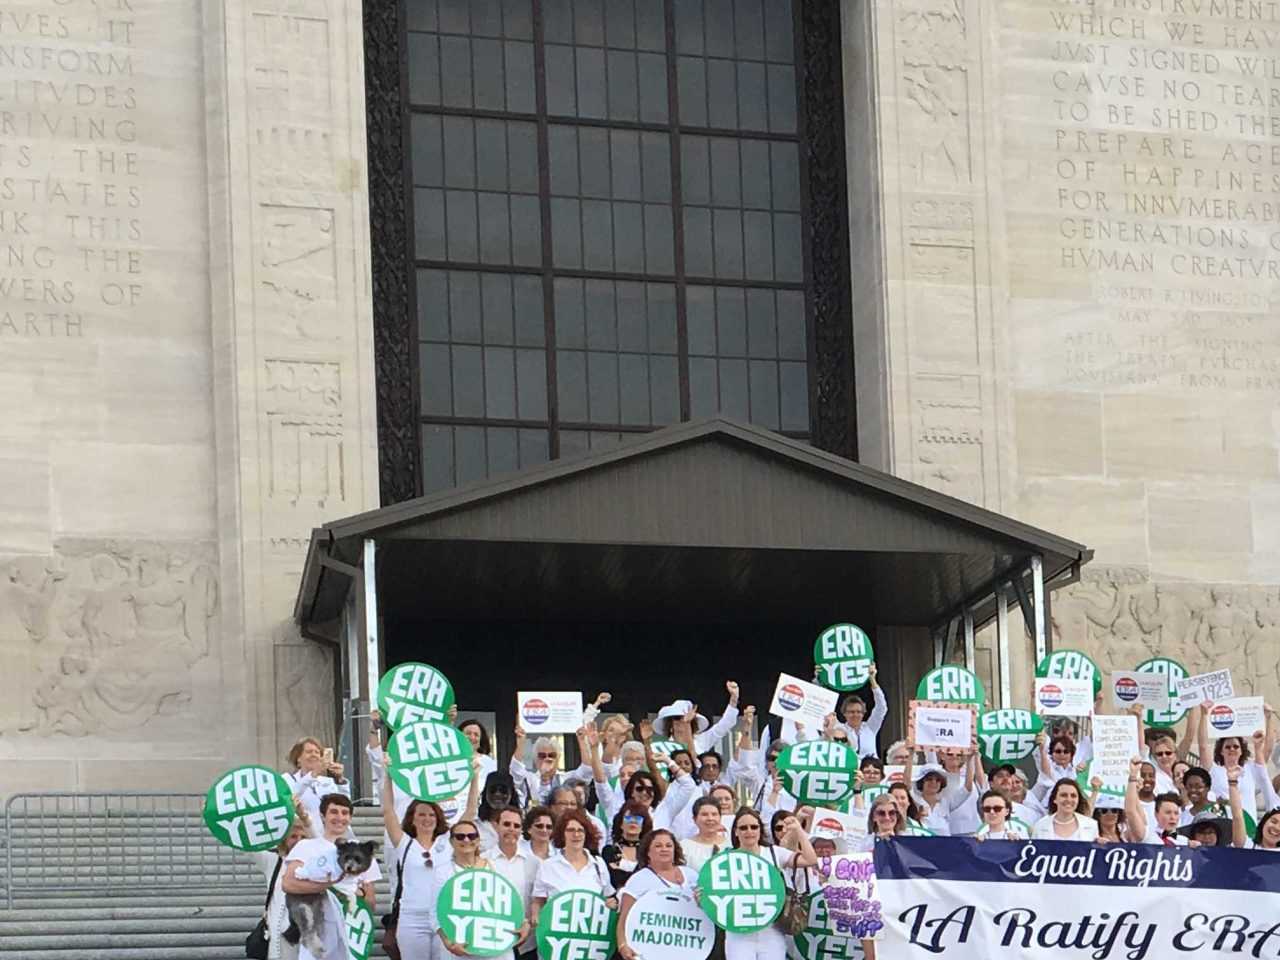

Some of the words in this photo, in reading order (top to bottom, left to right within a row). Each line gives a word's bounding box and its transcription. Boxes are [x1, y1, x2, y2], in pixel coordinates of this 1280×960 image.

[107, 20, 135, 43] IT
[1049, 11, 1146, 39] WHICH
[1164, 21, 1205, 45] WE
[1128, 47, 1220, 74] SIGNED
[1052, 71, 1145, 97] CAVSE
[1163, 79, 1200, 102] NO
[1053, 99, 1089, 122] TO
[1107, 104, 1135, 125] BE
[1151, 108, 1218, 132] SHED
[1055, 129, 1194, 159] PREPARE
[73, 149, 138, 176] THE
[1056, 158, 1096, 181] OF
[1057, 188, 1109, 212] FOR
[65, 215, 141, 241] THIS
[1059, 217, 1249, 249] GENERATIONS
[80, 247, 141, 274] THE
[1060, 247, 1154, 273] HVMAN
[100, 281, 143, 306] OF
[822, 625, 866, 659] ERA
[821, 661, 872, 686] YES
[1047, 651, 1095, 680] ERA
[390, 665, 448, 708] ERA
[926, 667, 976, 700] ERA
[936, 727, 954, 737] RA
[982, 709, 1032, 730] ERA
[396, 721, 460, 763] ERA
[789, 741, 846, 767] ERA
[980, 733, 1037, 760] YES
[215, 768, 279, 815] ERA
[398, 759, 470, 797] YES
[784, 770, 850, 800] YES
[216, 806, 289, 847] YES
[710, 852, 771, 890] ERA
[1014, 846, 1094, 883] Equal
[1104, 847, 1193, 887] Rights
[452, 871, 512, 916] ERA
[551, 892, 610, 935] ERA
[639, 911, 702, 932] FEMINIST
[707, 894, 777, 927] YES
[447, 914, 515, 950] YES
[631, 928, 706, 950] MAJORITY
[899, 903, 976, 954] LA
[993, 907, 1159, 960] Ratify
